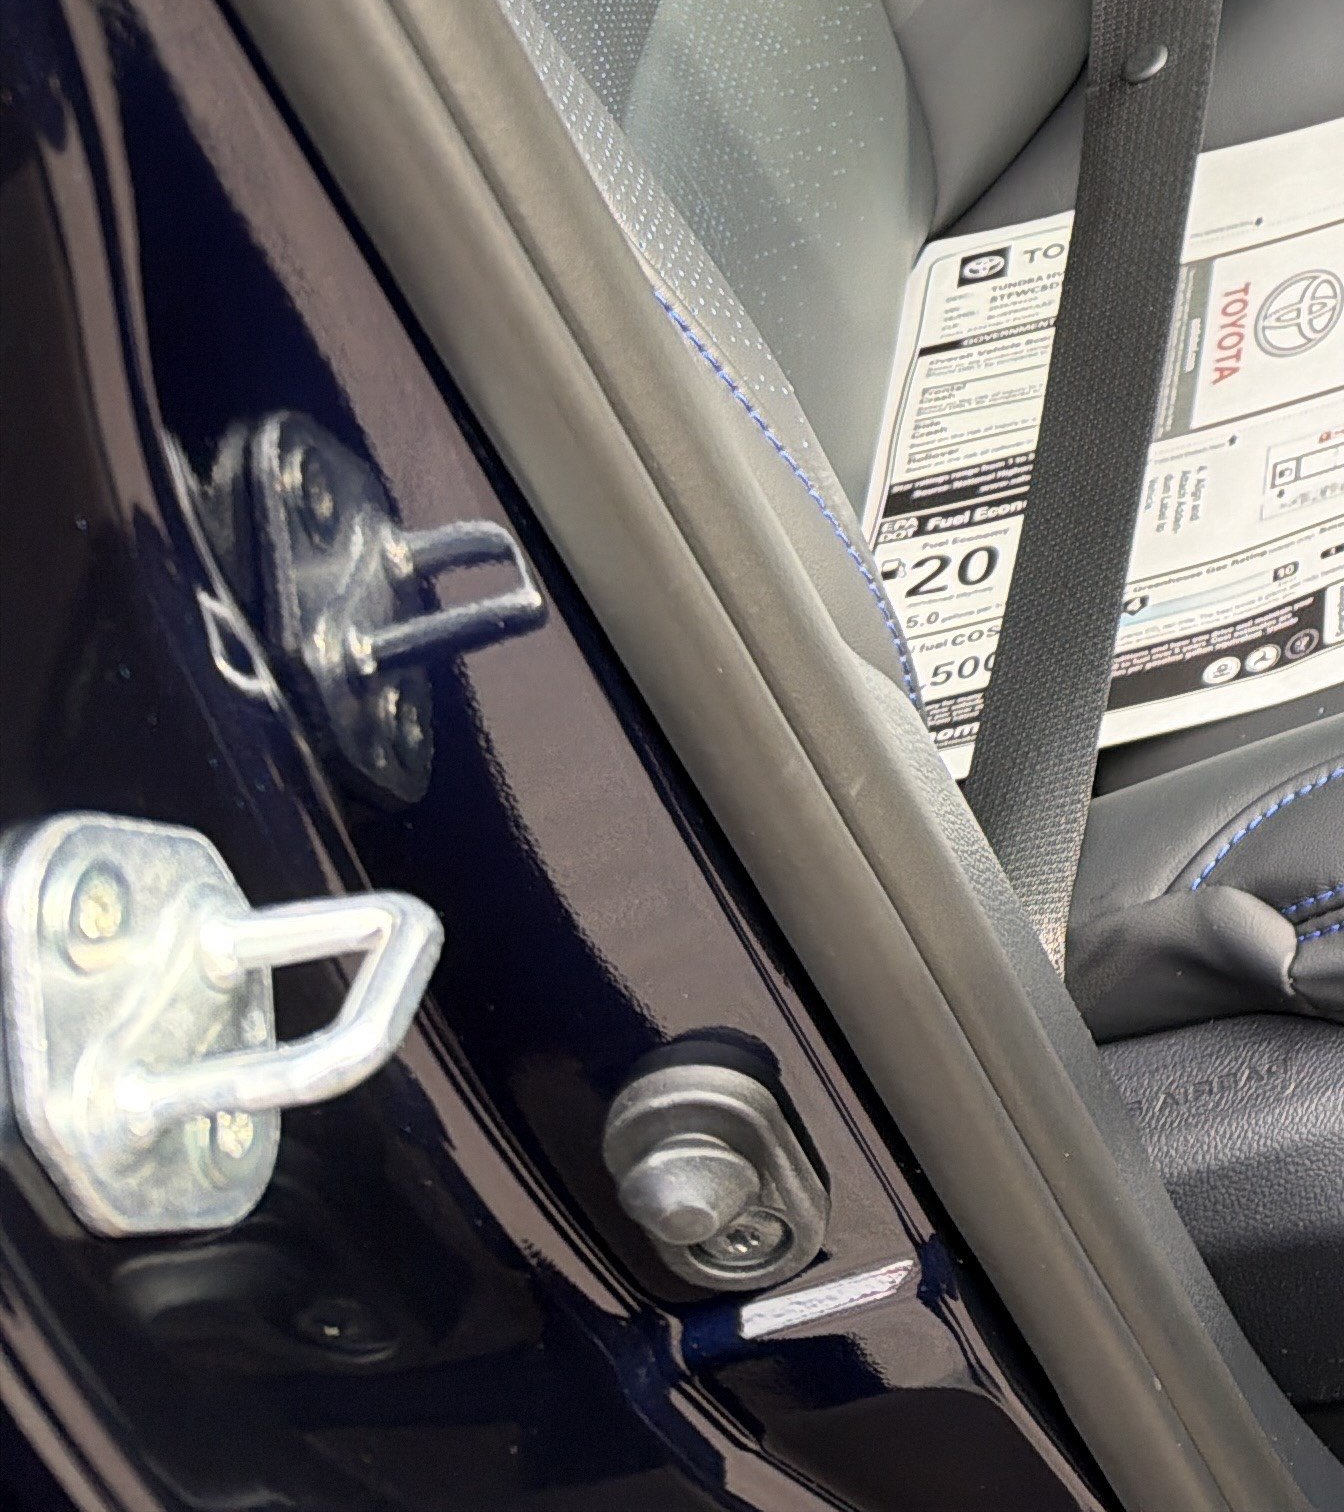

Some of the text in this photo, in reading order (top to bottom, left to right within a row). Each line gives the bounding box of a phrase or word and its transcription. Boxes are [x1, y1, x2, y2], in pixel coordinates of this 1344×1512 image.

[1211, 281, 1251, 386] TOYOTA
[926, 499, 1028, 531] Fuel Econ
[904, 544, 999, 599] 20
[905, 610, 940, 630] 5.0
